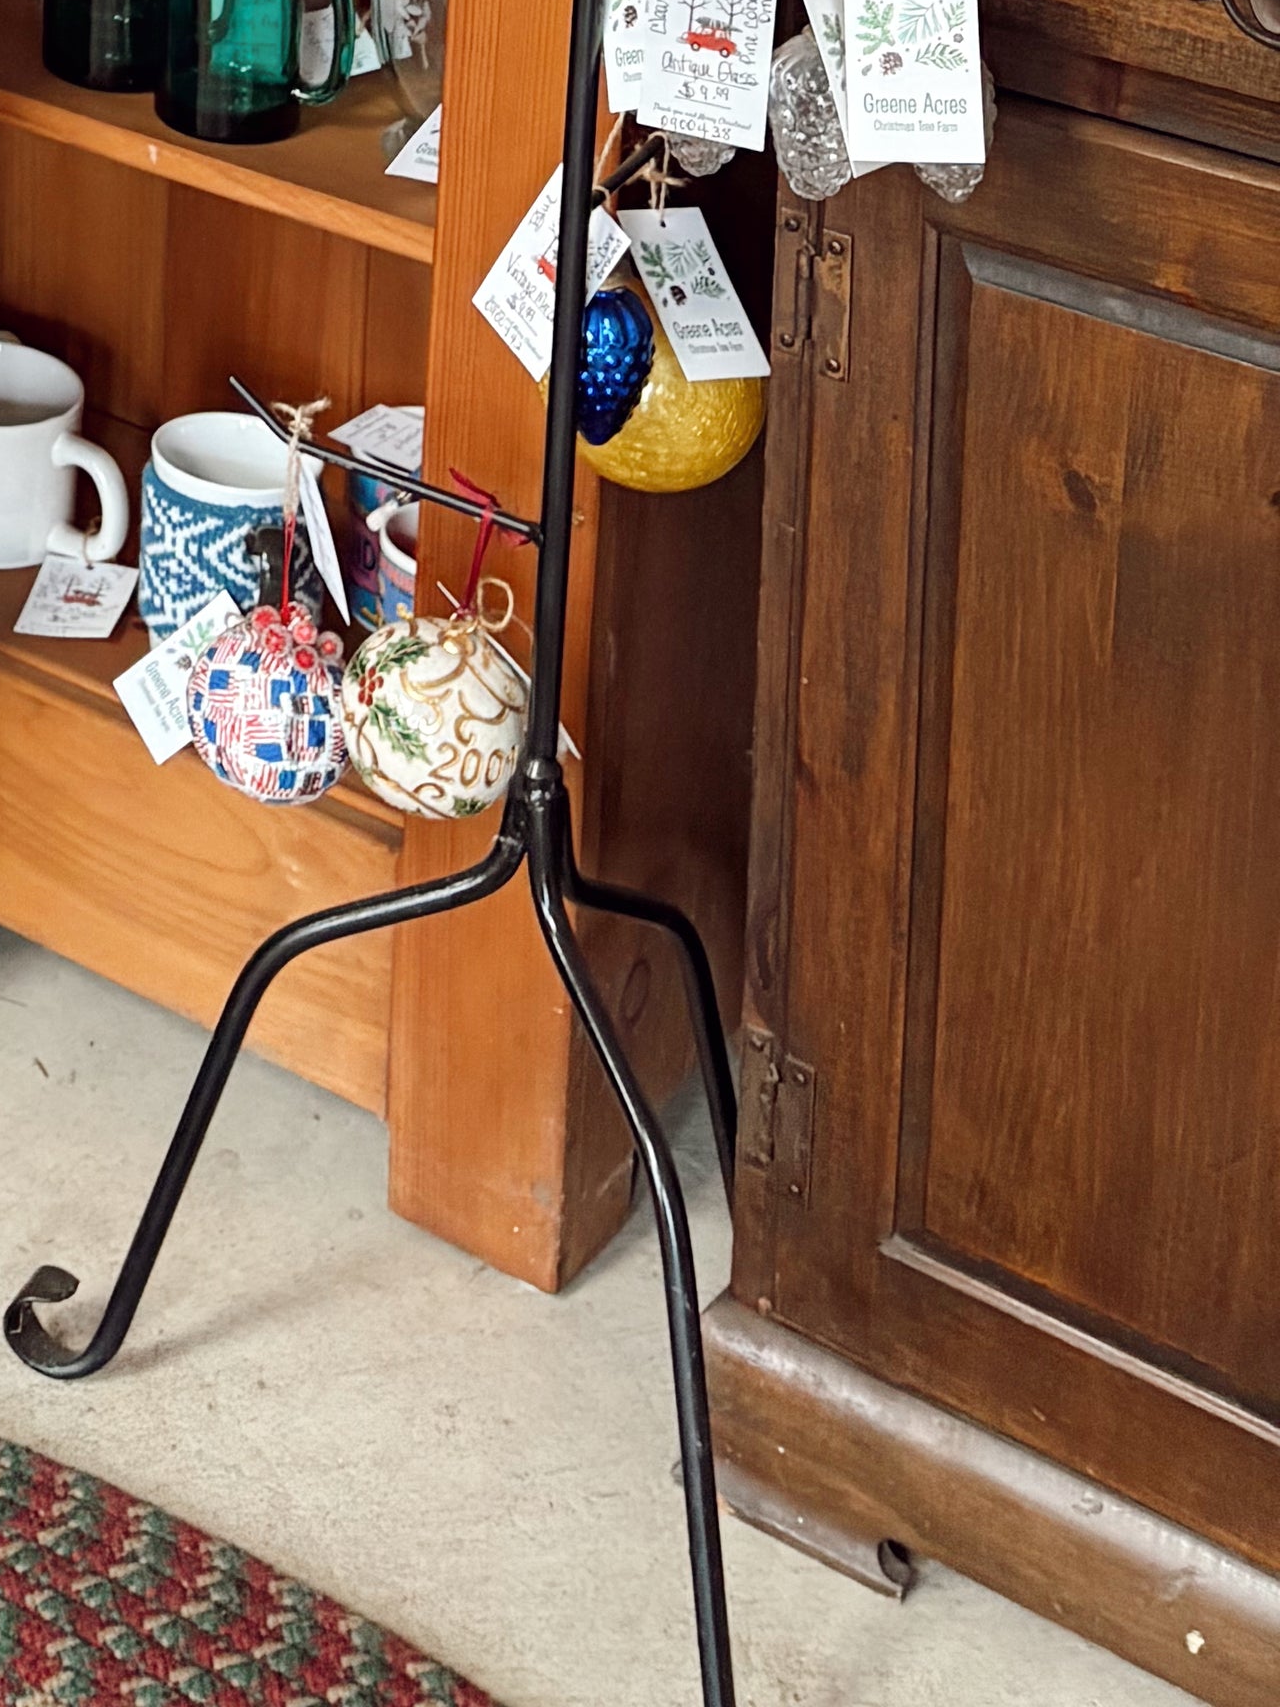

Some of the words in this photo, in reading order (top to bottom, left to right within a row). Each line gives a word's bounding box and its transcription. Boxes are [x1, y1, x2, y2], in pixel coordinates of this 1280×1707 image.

[863, 92, 917, 114] Greene
[923, 92, 967, 115] Acres
[873, 119, 915, 132] Christmas
[918, 120, 935, 131] Tree
[937, 121, 958, 132] Farm
[673, 321, 712, 339] Greene
[711, 318, 744, 337] Acres
[144, 659, 172, 700] Greene
[165, 696, 187, 731] Acres
